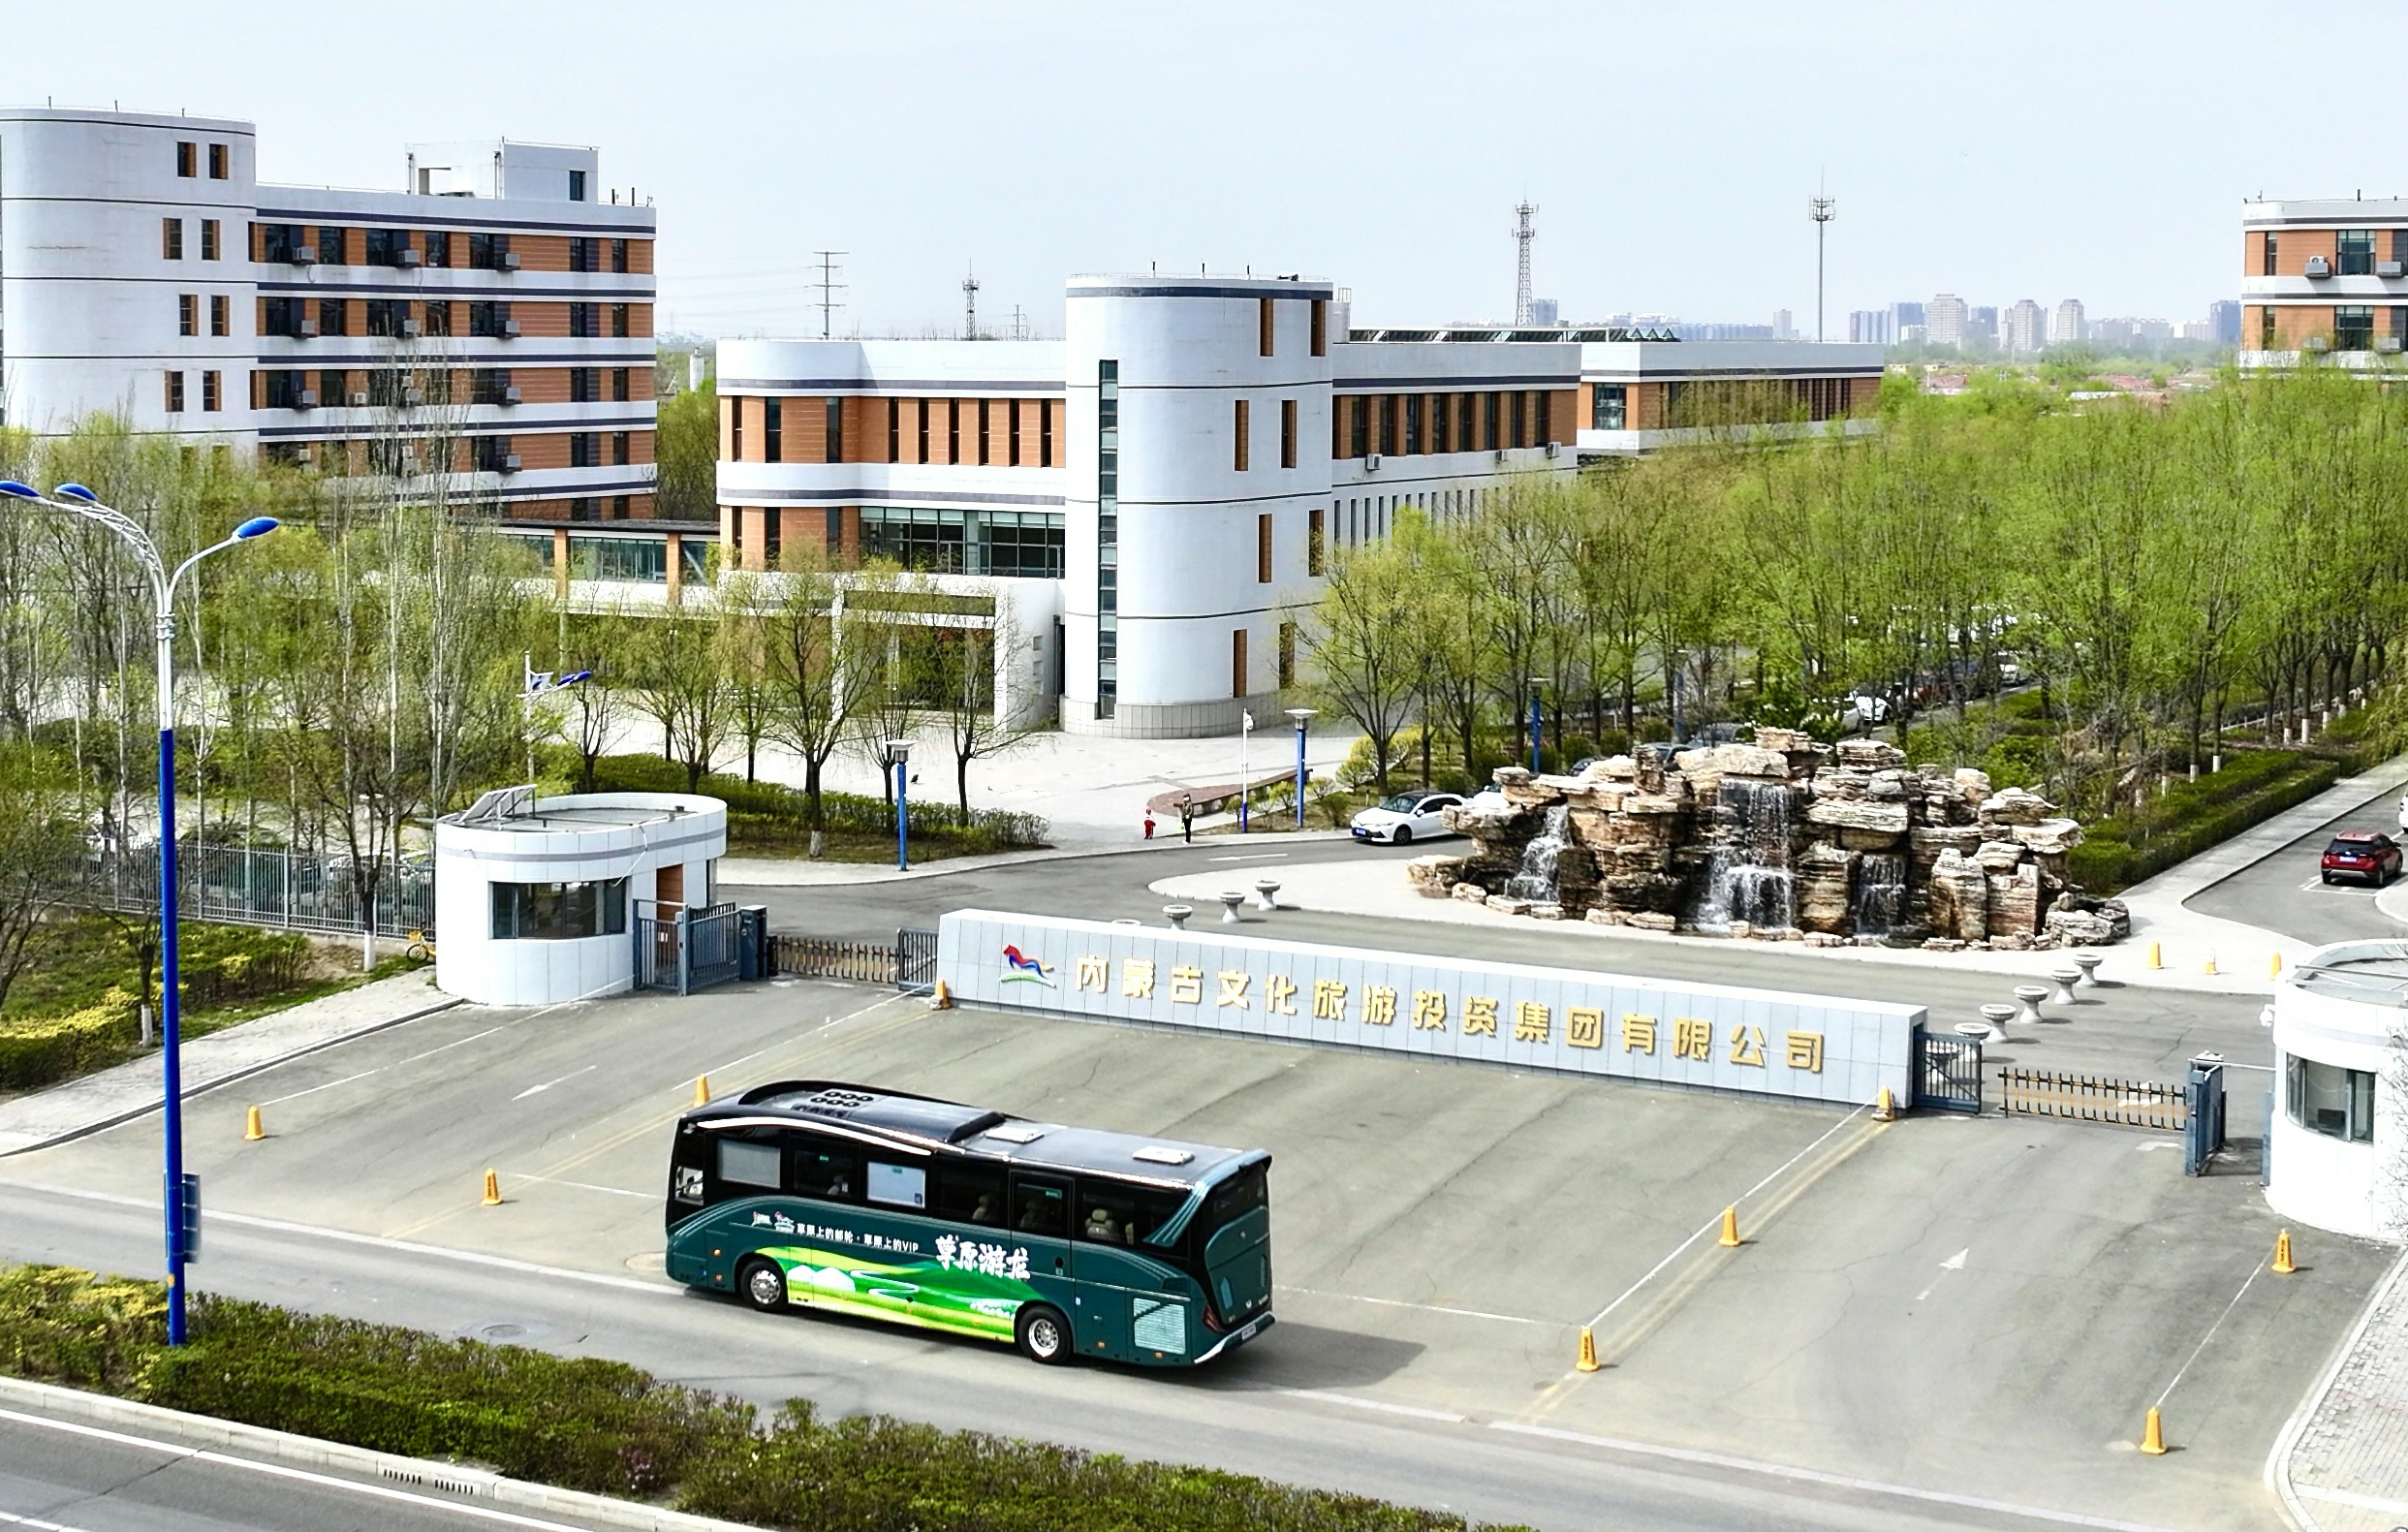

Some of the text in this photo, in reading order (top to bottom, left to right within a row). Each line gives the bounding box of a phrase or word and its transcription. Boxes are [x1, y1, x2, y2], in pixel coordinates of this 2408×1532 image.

[1076, 954, 1824, 1073] 内蒙古文化旅游投资集团有限公司
[935, 1234, 1031, 1280] 草原游龙
